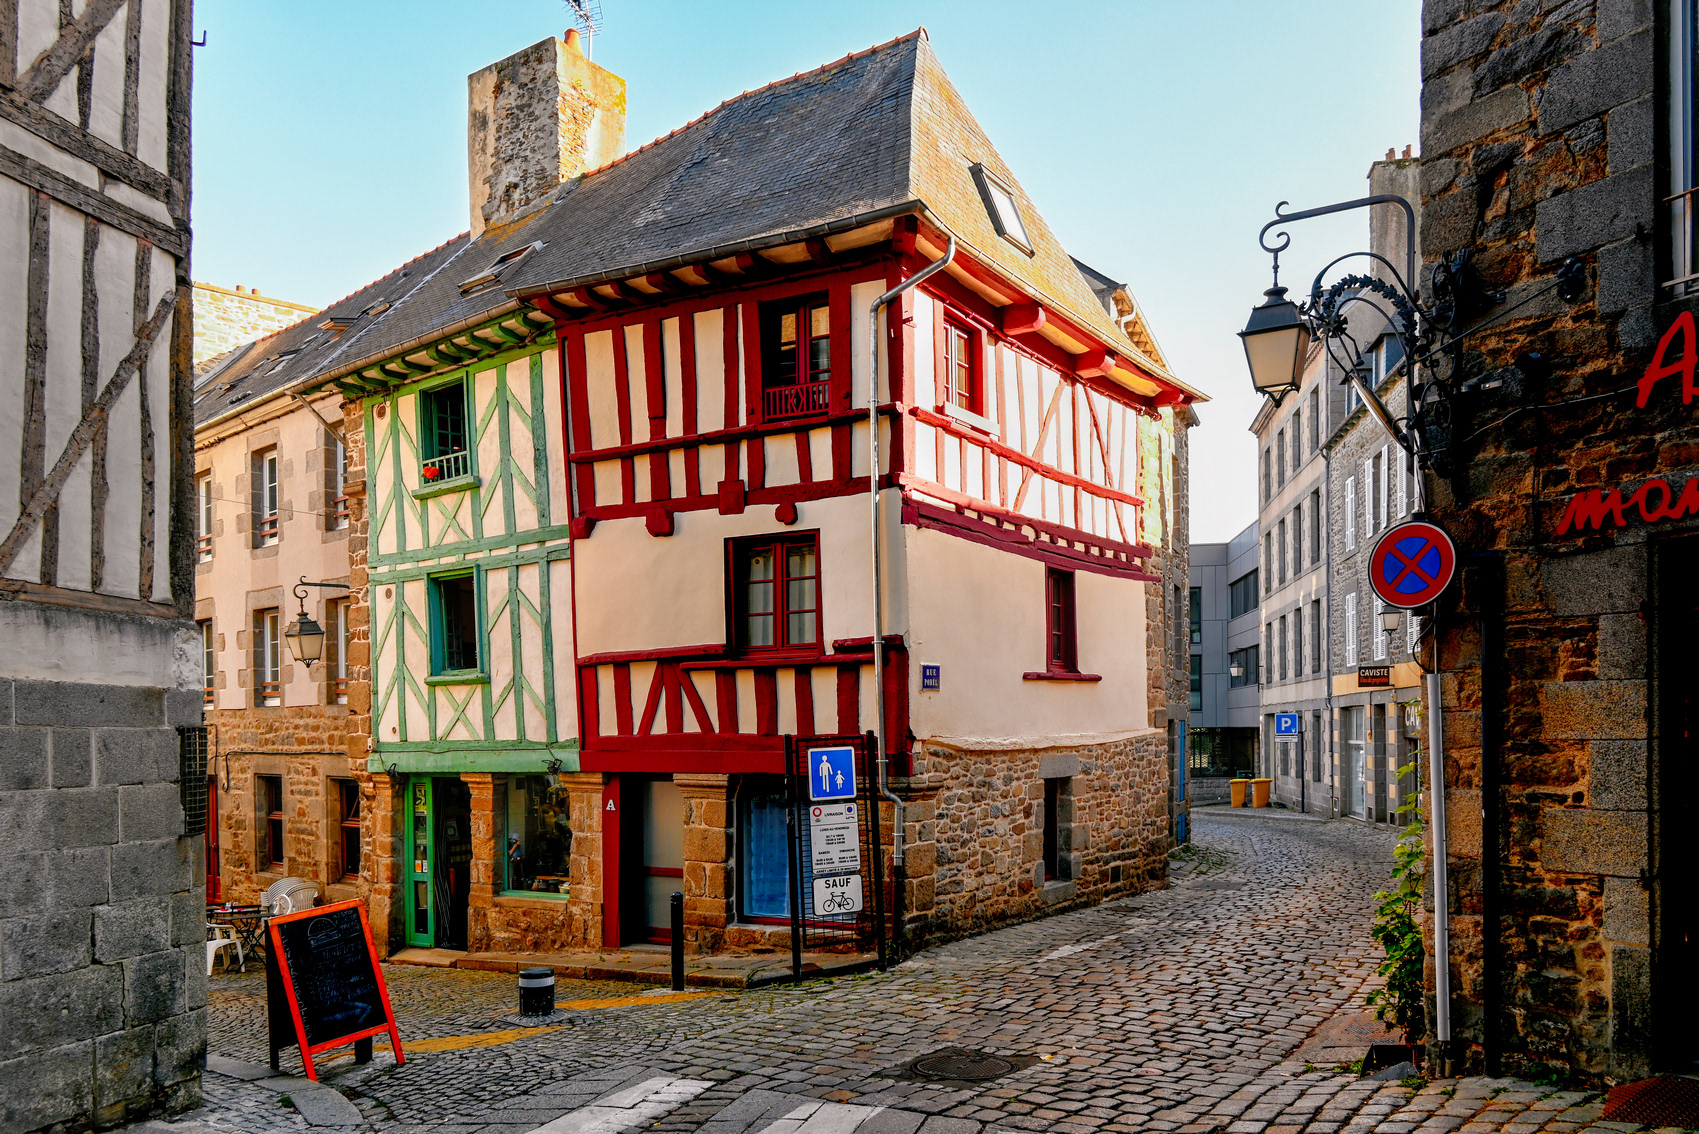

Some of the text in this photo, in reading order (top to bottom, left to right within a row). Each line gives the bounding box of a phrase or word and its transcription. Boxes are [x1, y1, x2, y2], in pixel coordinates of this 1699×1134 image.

[1360, 668, 1388, 677] CAVISTE
[1281, 717, 1292, 731] P
[605, 798, 616, 811] A
[824, 877, 851, 889] SAUF
